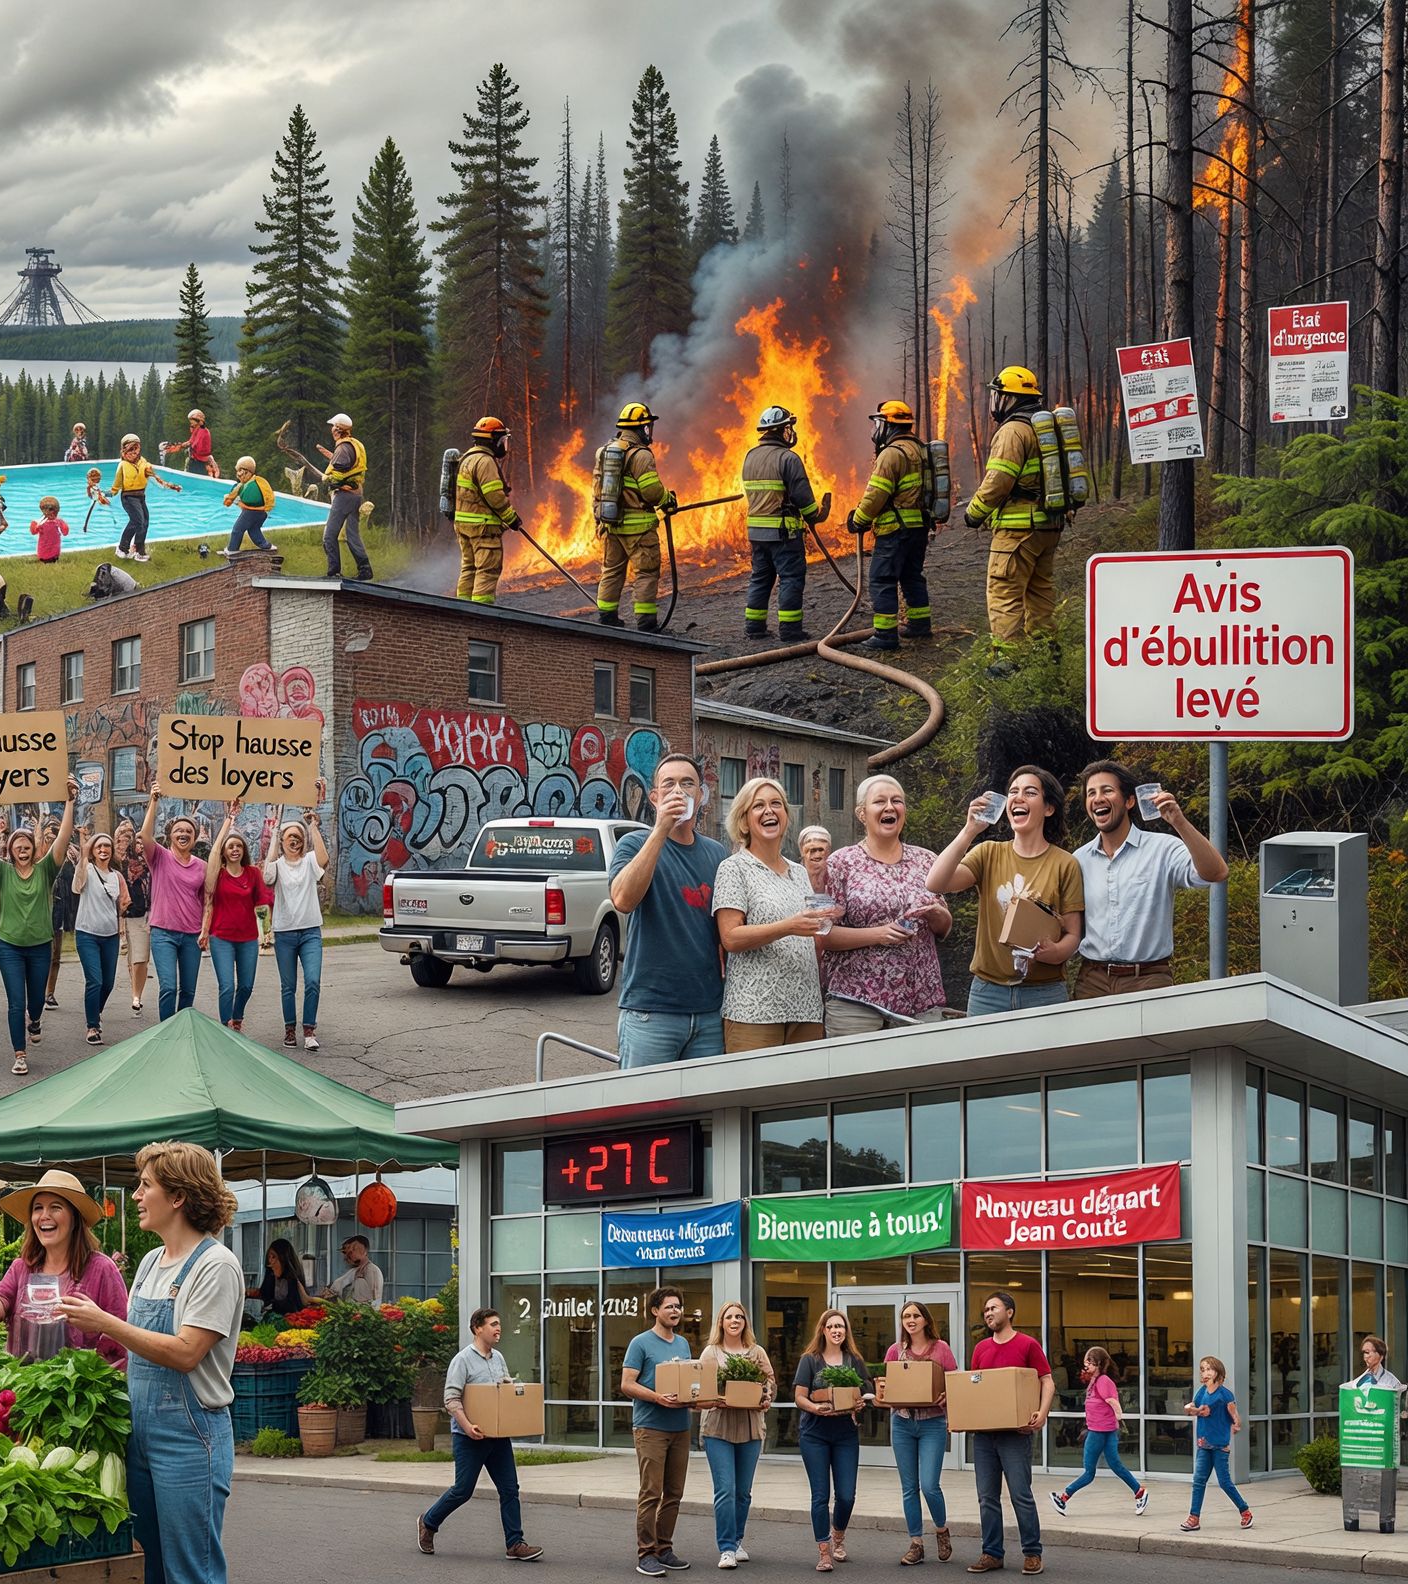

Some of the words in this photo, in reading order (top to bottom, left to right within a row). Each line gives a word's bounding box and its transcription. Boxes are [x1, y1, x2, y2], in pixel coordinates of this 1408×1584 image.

[1173, 572, 1262, 613] Avis
[1103, 624, 1334, 667] d'ébullition
[1176, 676, 1260, 718] levé
[169, 720, 224, 760] Stop
[236, 720, 312, 757] hausse
[169, 756, 209, 785] des
[222, 758, 293, 798] loyers
[649, 1138, 670, 1184] C
[758, 1212, 862, 1240] Bienvenue
[869, 1212, 880, 1237] à
[1004, 1220, 1055, 1246] Jean
[518, 1297, 531, 1318] 2
